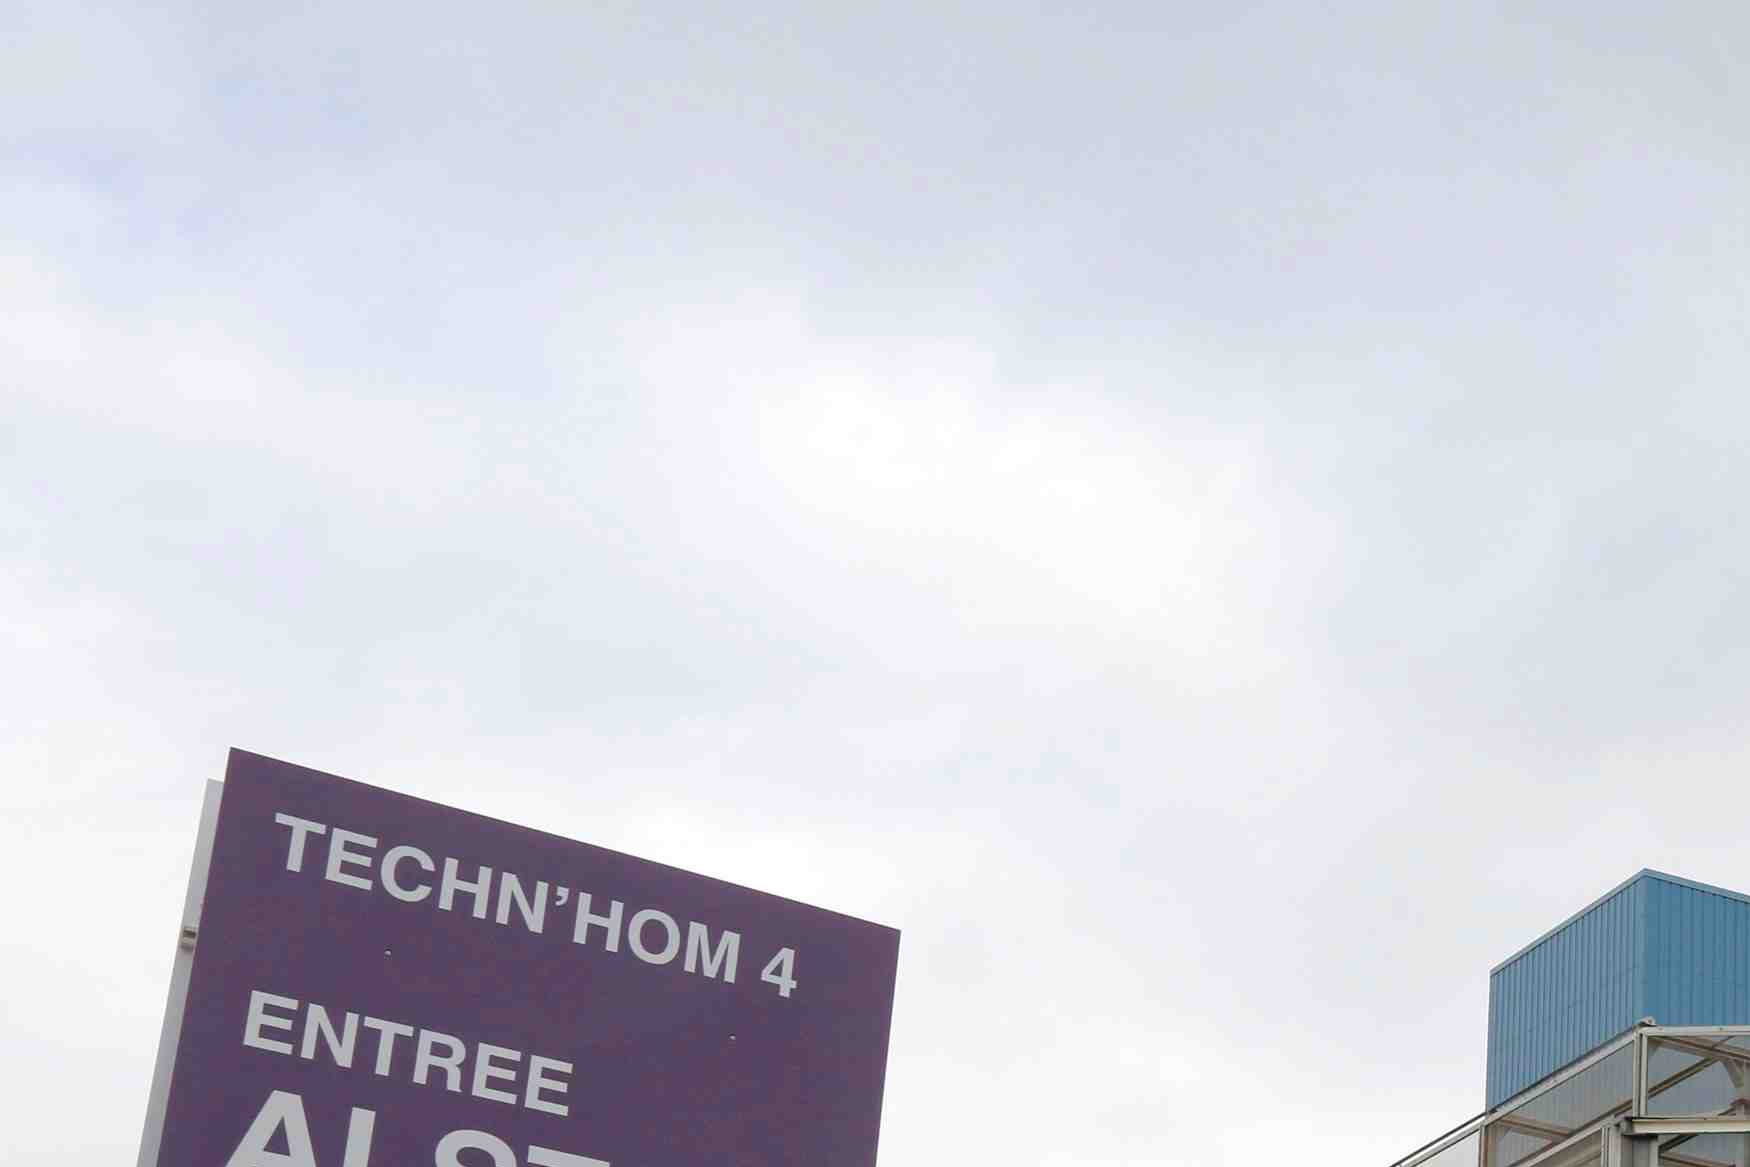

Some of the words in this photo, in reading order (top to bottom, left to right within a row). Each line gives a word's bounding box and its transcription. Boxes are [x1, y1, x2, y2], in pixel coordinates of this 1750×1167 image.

[274, 812, 741, 984] TECHN'HOM
[760, 947, 798, 998] 4
[242, 989, 574, 1117] ENTREE
